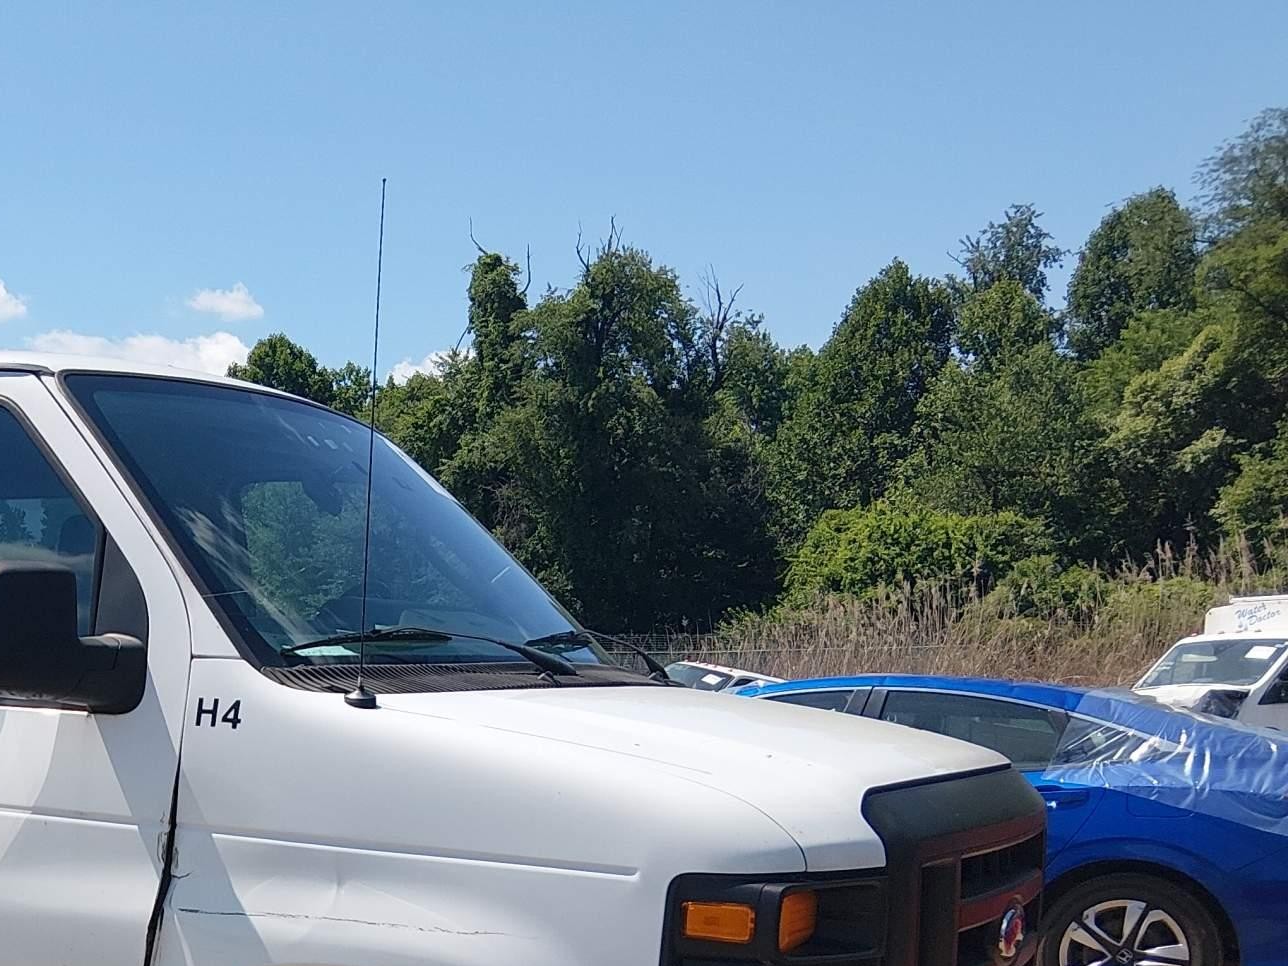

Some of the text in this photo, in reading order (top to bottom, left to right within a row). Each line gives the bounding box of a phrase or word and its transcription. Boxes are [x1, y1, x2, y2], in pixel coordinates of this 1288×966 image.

[1235, 602, 1267, 619] Water
[1247, 609, 1281, 626] Doctor
[195, 697, 242, 730] H4
